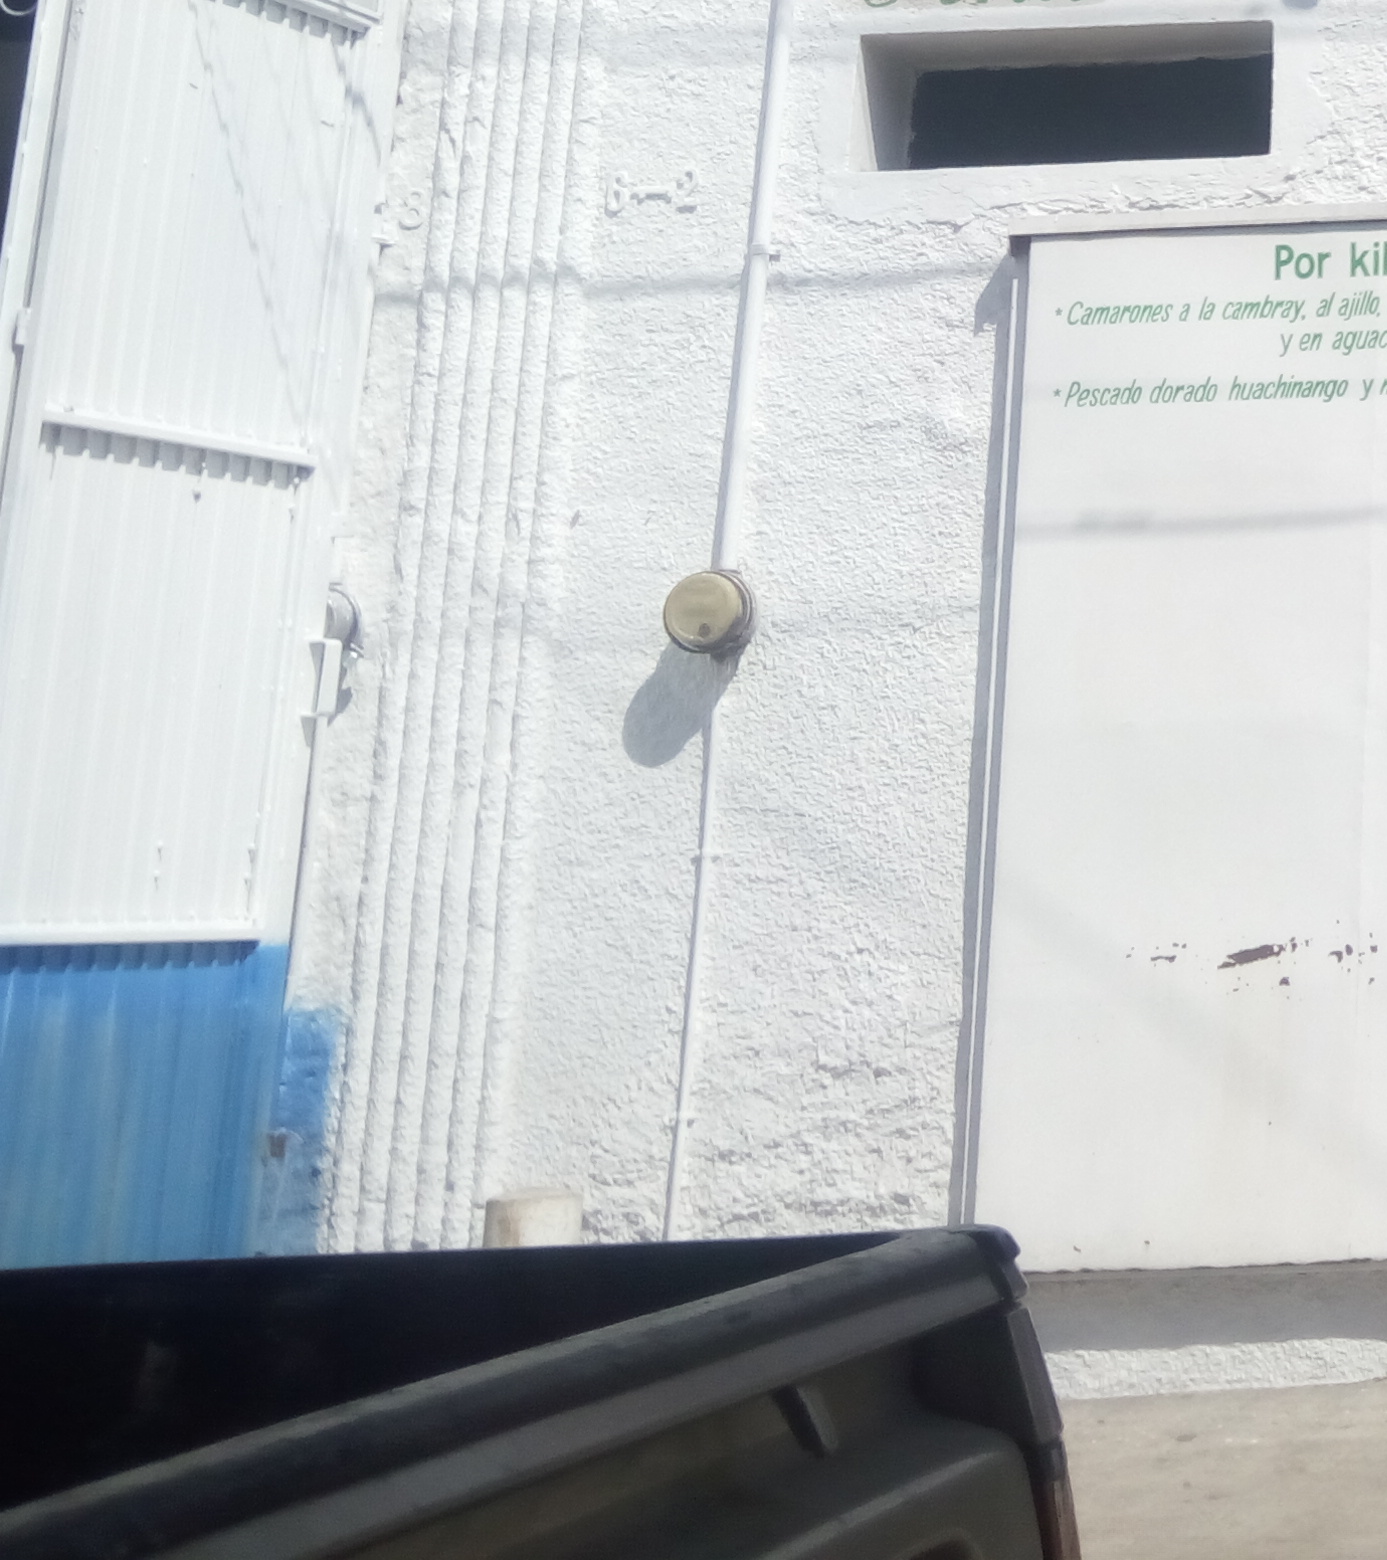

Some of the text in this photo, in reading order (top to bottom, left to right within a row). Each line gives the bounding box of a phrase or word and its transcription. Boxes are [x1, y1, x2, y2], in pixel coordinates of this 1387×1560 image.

[1274, 243, 1332, 281] Por
[1066, 300, 1173, 326] Camarones
[1178, 303, 1191, 322] a
[1197, 296, 1216, 321] la
[1222, 294, 1307, 323] cambray,
[1316, 291, 1336, 318] al
[1278, 333, 1293, 358] y
[1299, 332, 1323, 352] en
[1063, 378, 1143, 408] Pescado
[1149, 376, 1219, 404] dorado
[1228, 374, 1348, 403] huachinango
[1359, 378, 1375, 402] y
